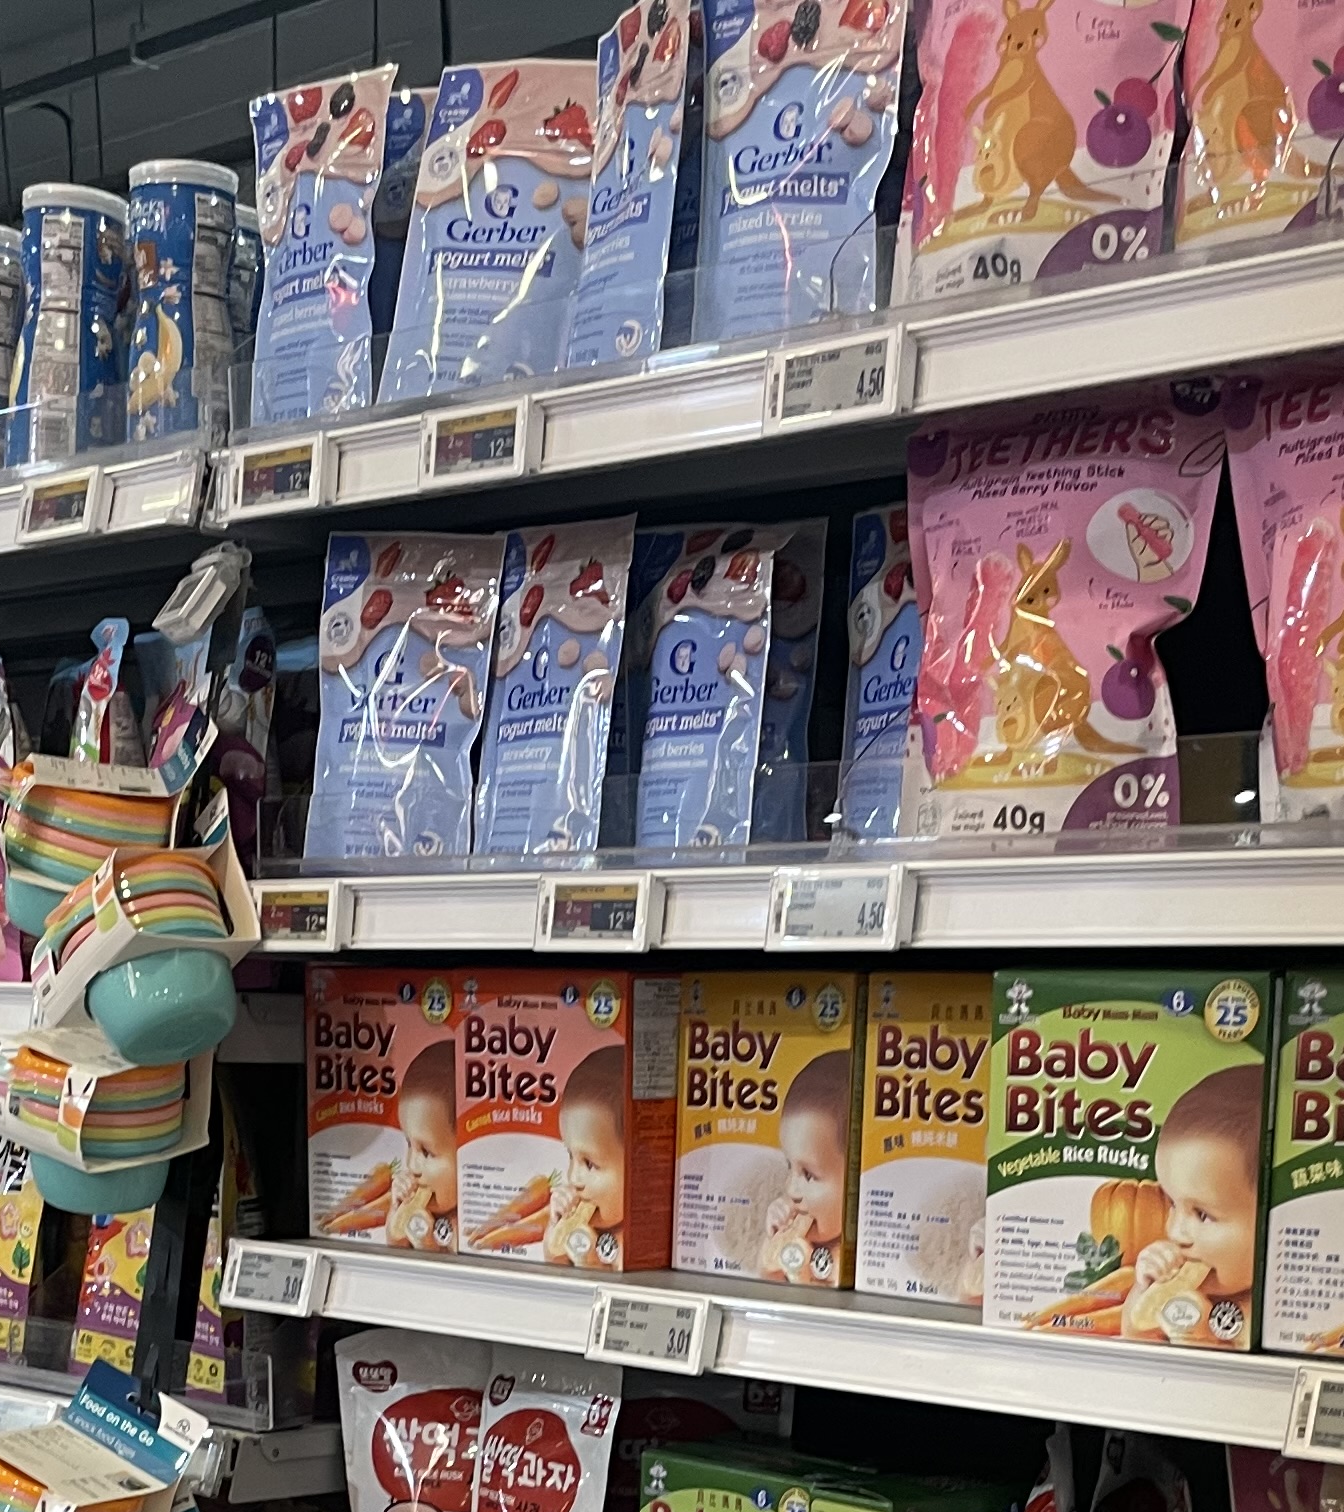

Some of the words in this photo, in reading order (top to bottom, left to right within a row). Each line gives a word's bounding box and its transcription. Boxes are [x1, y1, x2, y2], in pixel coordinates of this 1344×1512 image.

[734, 136, 833, 176] Gerber
[779, 174, 842, 202] melts
[445, 217, 548, 246] Gerber
[1090, 222, 1151, 264] 0%
[971, 248, 1023, 285] 40g
[853, 364, 883, 400] 4.50
[1053, 478, 1100, 494] Flavor
[1086, 463, 1126, 479] Stick
[507, 681, 572, 712] Gerber
[863, 672, 918, 704] Gerbe
[1111, 770, 1172, 811] 0%
[992, 803, 1047, 834] 40g
[855, 900, 886, 932] 4.50
[592, 996, 615, 1016] 25
[1215, 1004, 1248, 1027] 25
[312, 1012, 396, 1060] Baby
[462, 1014, 558, 1065] Baby
[686, 1020, 783, 1072] Baby
[875, 1023, 990, 1081] Baby
[312, 1054, 398, 1099] Bites
[1006, 1026, 1160, 1092] Baby
[462, 1060, 558, 1106] Bites
[685, 1067, 779, 1113] Bites
[873, 1073, 986, 1126] Bites
[1004, 1083, 1156, 1142] Bites
[997, 1146, 1061, 1178] Vegetable
[1063, 1144, 1095, 1165] Rice
[1097, 1144, 1150, 1171] Rusks
[666, 1327, 692, 1359] 3.01
[80, 1393, 108, 1419] Food
[106, 1411, 121, 1427] on
[121, 1418, 138, 1438] the
[138, 1429, 155, 1447] Go
